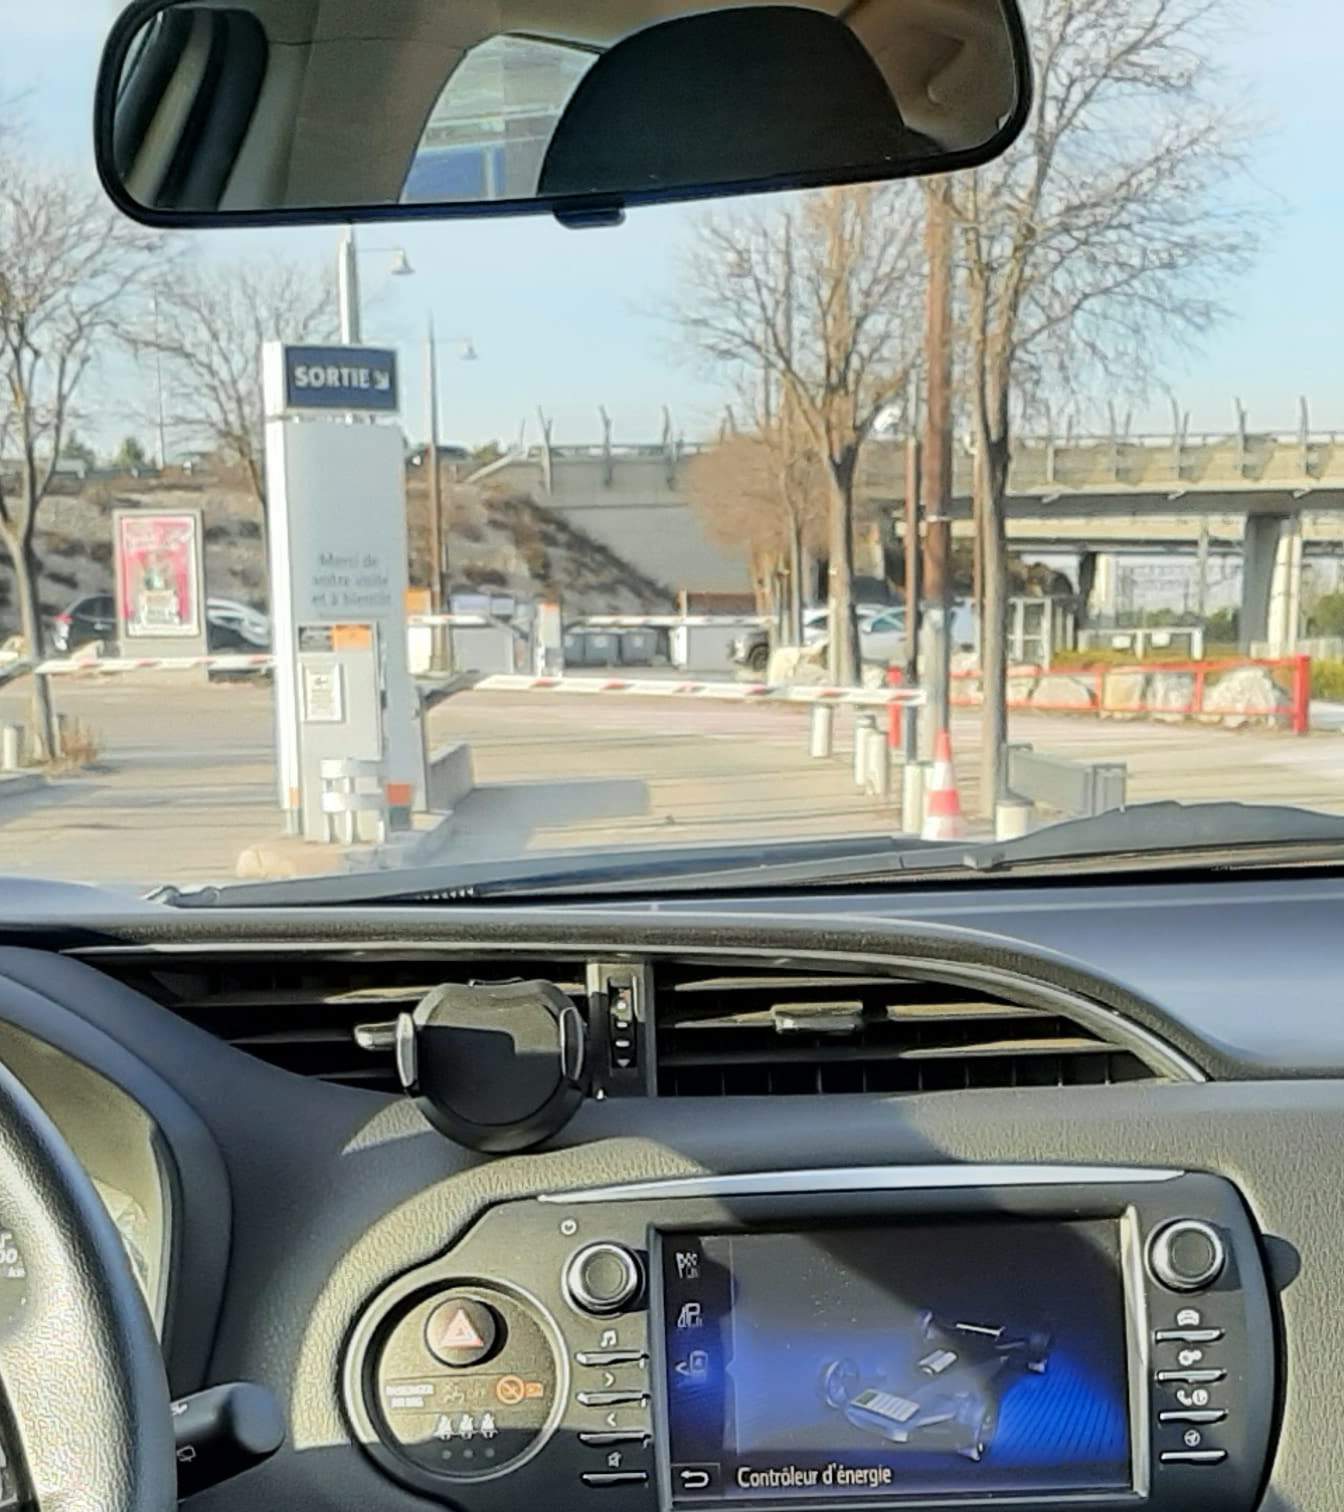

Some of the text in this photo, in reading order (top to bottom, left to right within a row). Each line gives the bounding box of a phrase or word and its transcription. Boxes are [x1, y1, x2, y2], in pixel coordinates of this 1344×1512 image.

[294, 365, 370, 389] SORTIE
[737, 1462, 892, 1488] Contrôleur d'énergie
